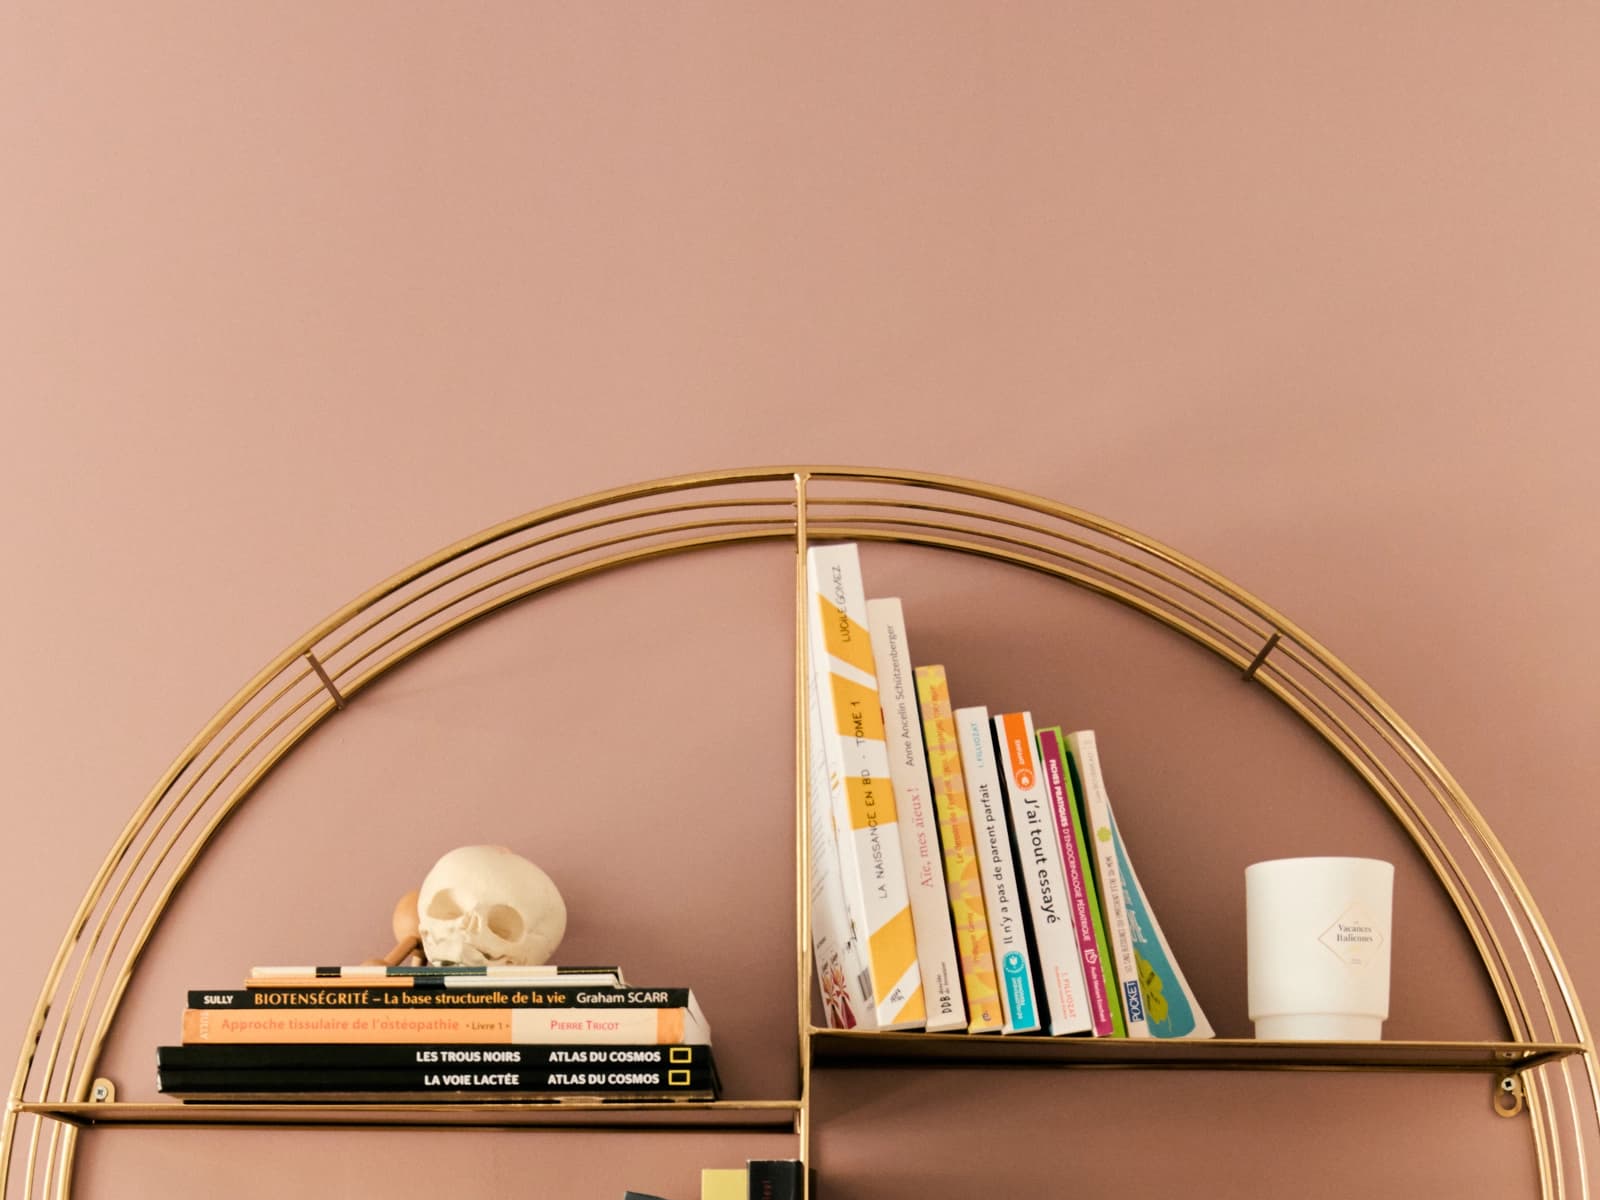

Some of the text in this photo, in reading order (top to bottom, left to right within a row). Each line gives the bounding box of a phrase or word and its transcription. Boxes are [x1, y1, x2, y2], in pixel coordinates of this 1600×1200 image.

[832, 566, 850, 642] LUCILE GOMEZ
[852, 713, 866, 745] TOME
[898, 703, 910, 738] Ancelin
[904, 741, 914, 767] Anne
[861, 773, 872, 786] BD
[865, 791, 875, 806] EN
[1049, 759, 1060, 785] FICHES
[1055, 786, 1068, 827] PRATIQUES
[980, 784, 995, 822] parfait
[866, 810, 883, 878] NAISSANCE
[918, 832, 928, 857] mes
[987, 826, 1002, 863] parent
[1024, 799, 1060, 923] J'ai tout essayé
[921, 861, 933, 888] Aïe,
[993, 867, 1003, 880] de
[878, 884, 887, 898] LA
[997, 884, 1008, 903] pas
[1000, 916, 1013, 933] n'y
[1003, 936, 1013, 944] Il
[204, 995, 234, 1005] SULLY
[254, 990, 369, 1005] BIOTENSÉGRITÉ
[384, 993, 399, 1004] La
[402, 992, 432, 1004] base
[435, 992, 508, 1004] structurelle
[512, 992, 528, 1004] de
[532, 992, 544, 1004] la
[546, 992, 566, 1004] vie
[576, 992, 668, 1004] Graham SCARR
[940, 996, 952, 1014] DDB
[1125, 979, 1142, 1022] POCKET
[221, 1018, 460, 1032] Approche tissulaire de l'ostéopathie
[471, 1022, 503, 1030] Livre 1
[416, 1051, 521, 1062] LES TROUS NOIRS
[549, 1051, 662, 1062] ATLAS DU COSMOS
[424, 1073, 520, 1086] LA VOIE LACTÉE
[548, 1073, 660, 1085] ATLAS DU COSMOS
